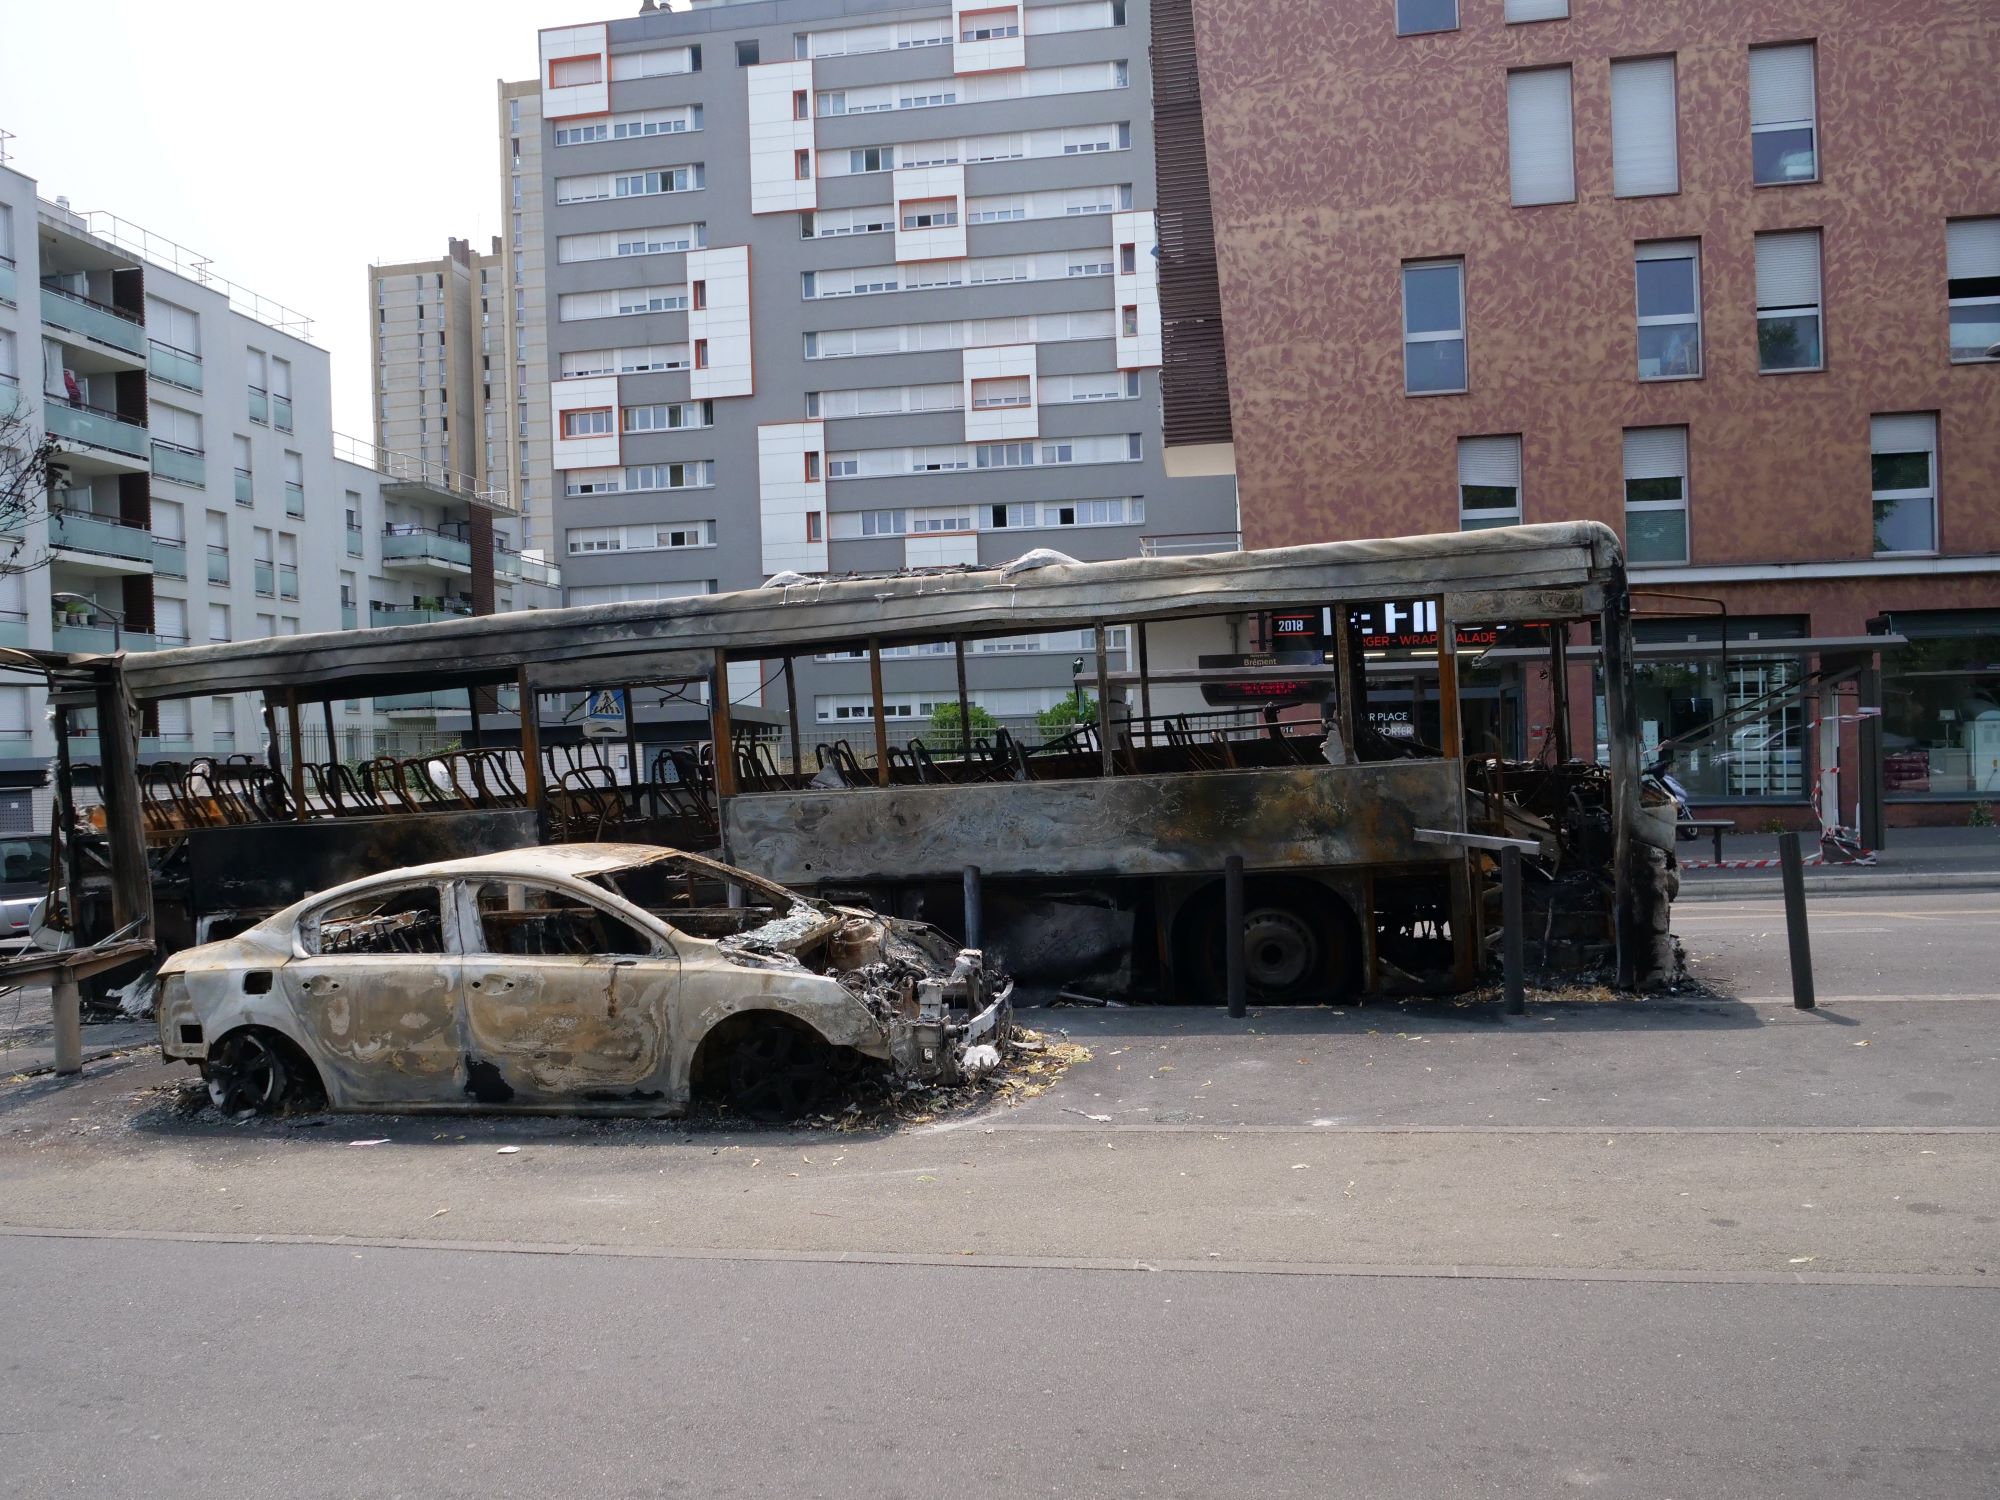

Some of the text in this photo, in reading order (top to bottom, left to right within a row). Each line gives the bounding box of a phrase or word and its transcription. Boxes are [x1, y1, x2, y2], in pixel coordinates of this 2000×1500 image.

[1278, 619, 1304, 632] 2018
[1400, 634, 1438, 646] WRAP
[1456, 632, 1497, 644] ALADE
[1243, 658, 1277, 667] Brément
[1377, 711, 1408, 721] PLACE
[1377, 726, 1412, 736] PORTER
